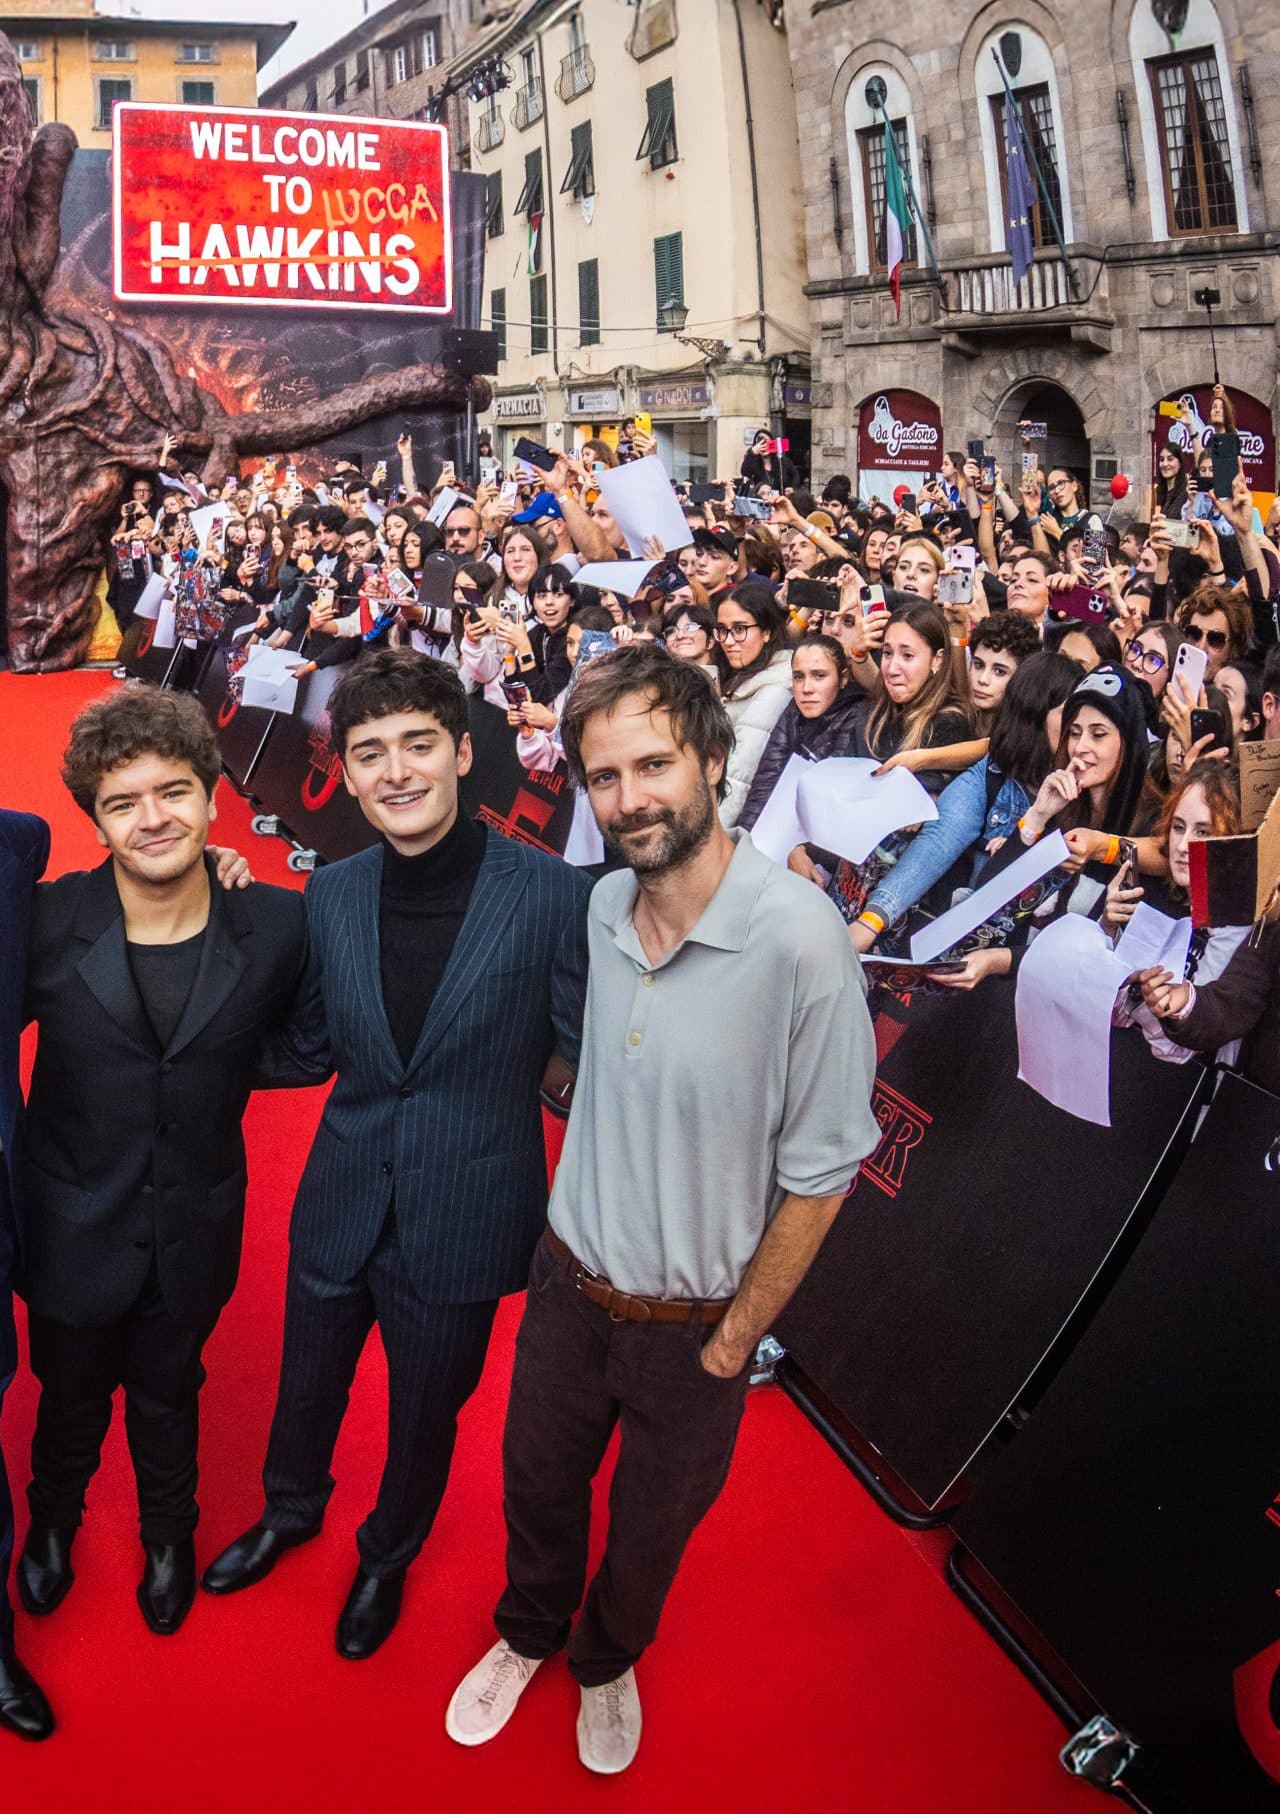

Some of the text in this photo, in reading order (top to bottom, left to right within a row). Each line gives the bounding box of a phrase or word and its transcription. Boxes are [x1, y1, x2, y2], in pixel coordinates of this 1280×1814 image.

[189, 121, 381, 171] WELCOME
[262, 174, 313, 215] TO
[148, 221, 421, 296] HAWKINS
[495, 398, 540, 417] FARMACIA
[875, 421, 937, 455] da Gastone
